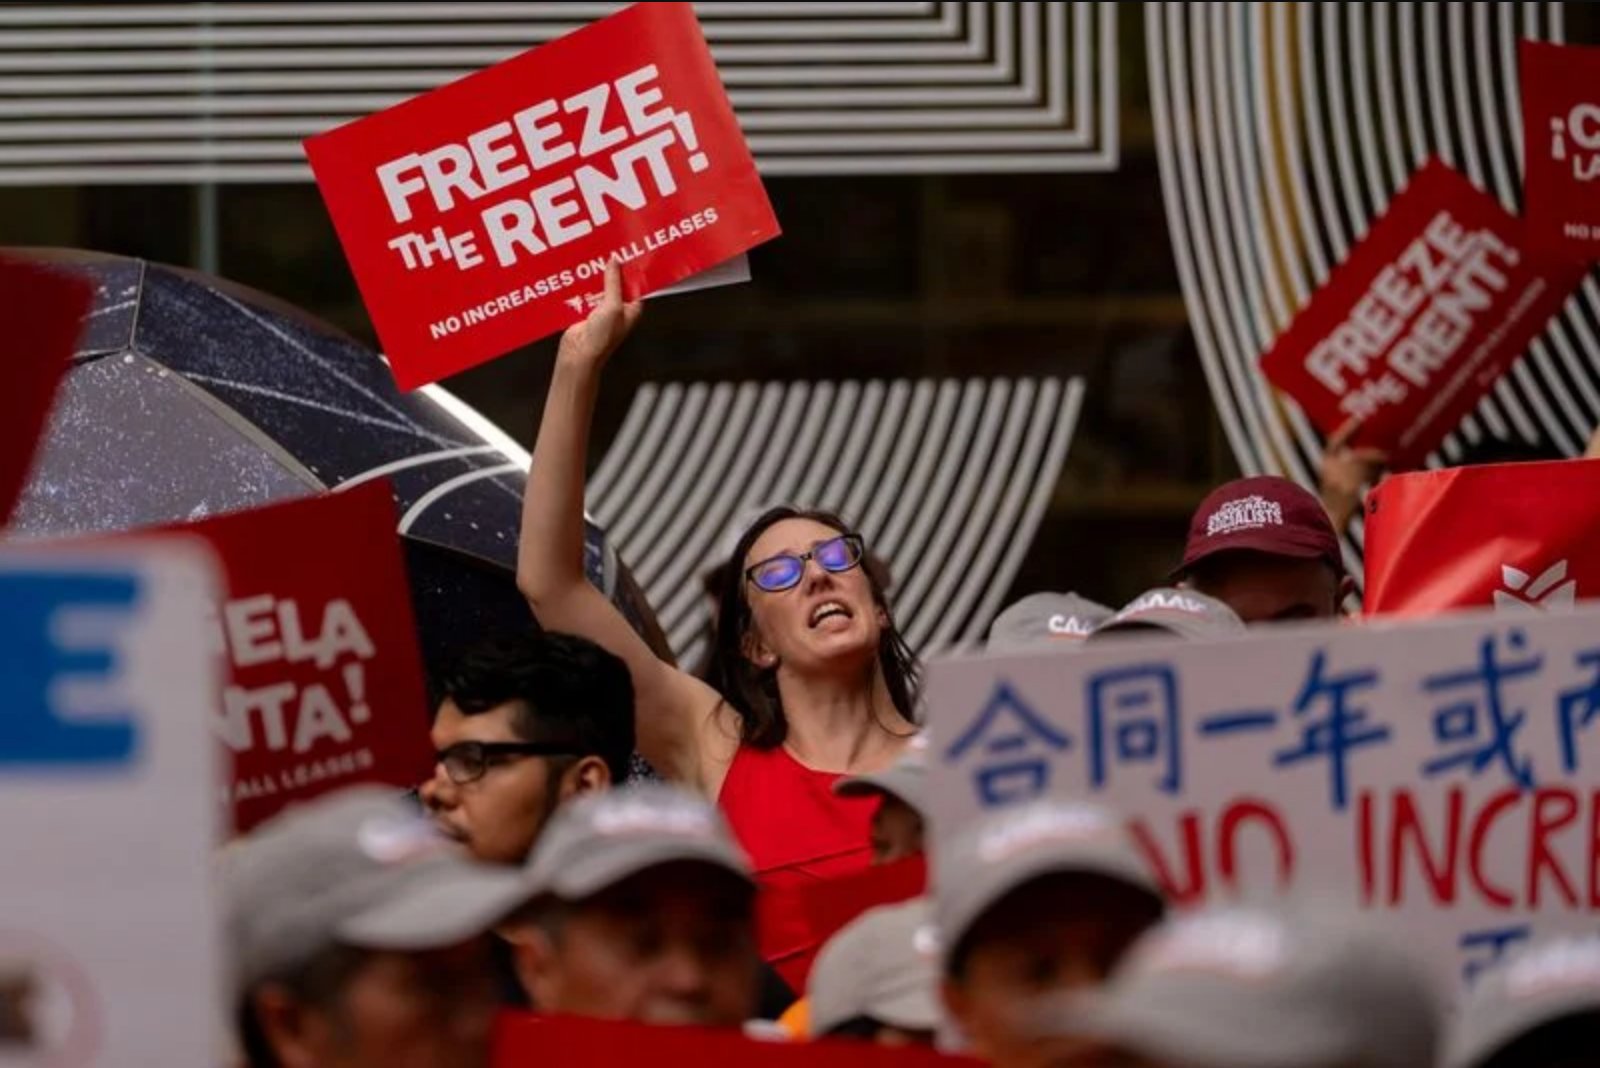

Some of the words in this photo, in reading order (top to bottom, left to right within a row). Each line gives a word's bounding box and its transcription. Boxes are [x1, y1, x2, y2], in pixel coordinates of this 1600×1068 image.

[376, 64, 675, 224] FREEZE
[388, 226, 483, 271] THE
[481, 111, 709, 268] RENT!
[429, 316, 461, 340] NO
[462, 269, 575, 328] INCREASES
[576, 256, 606, 280] ON
[610, 241, 645, 264] ALL
[643, 207, 719, 252] LEASES
[1304, 210, 1467, 397] FREEZE
[1386, 228, 1520, 389] RENT!
[214, 594, 376, 669] ELA
